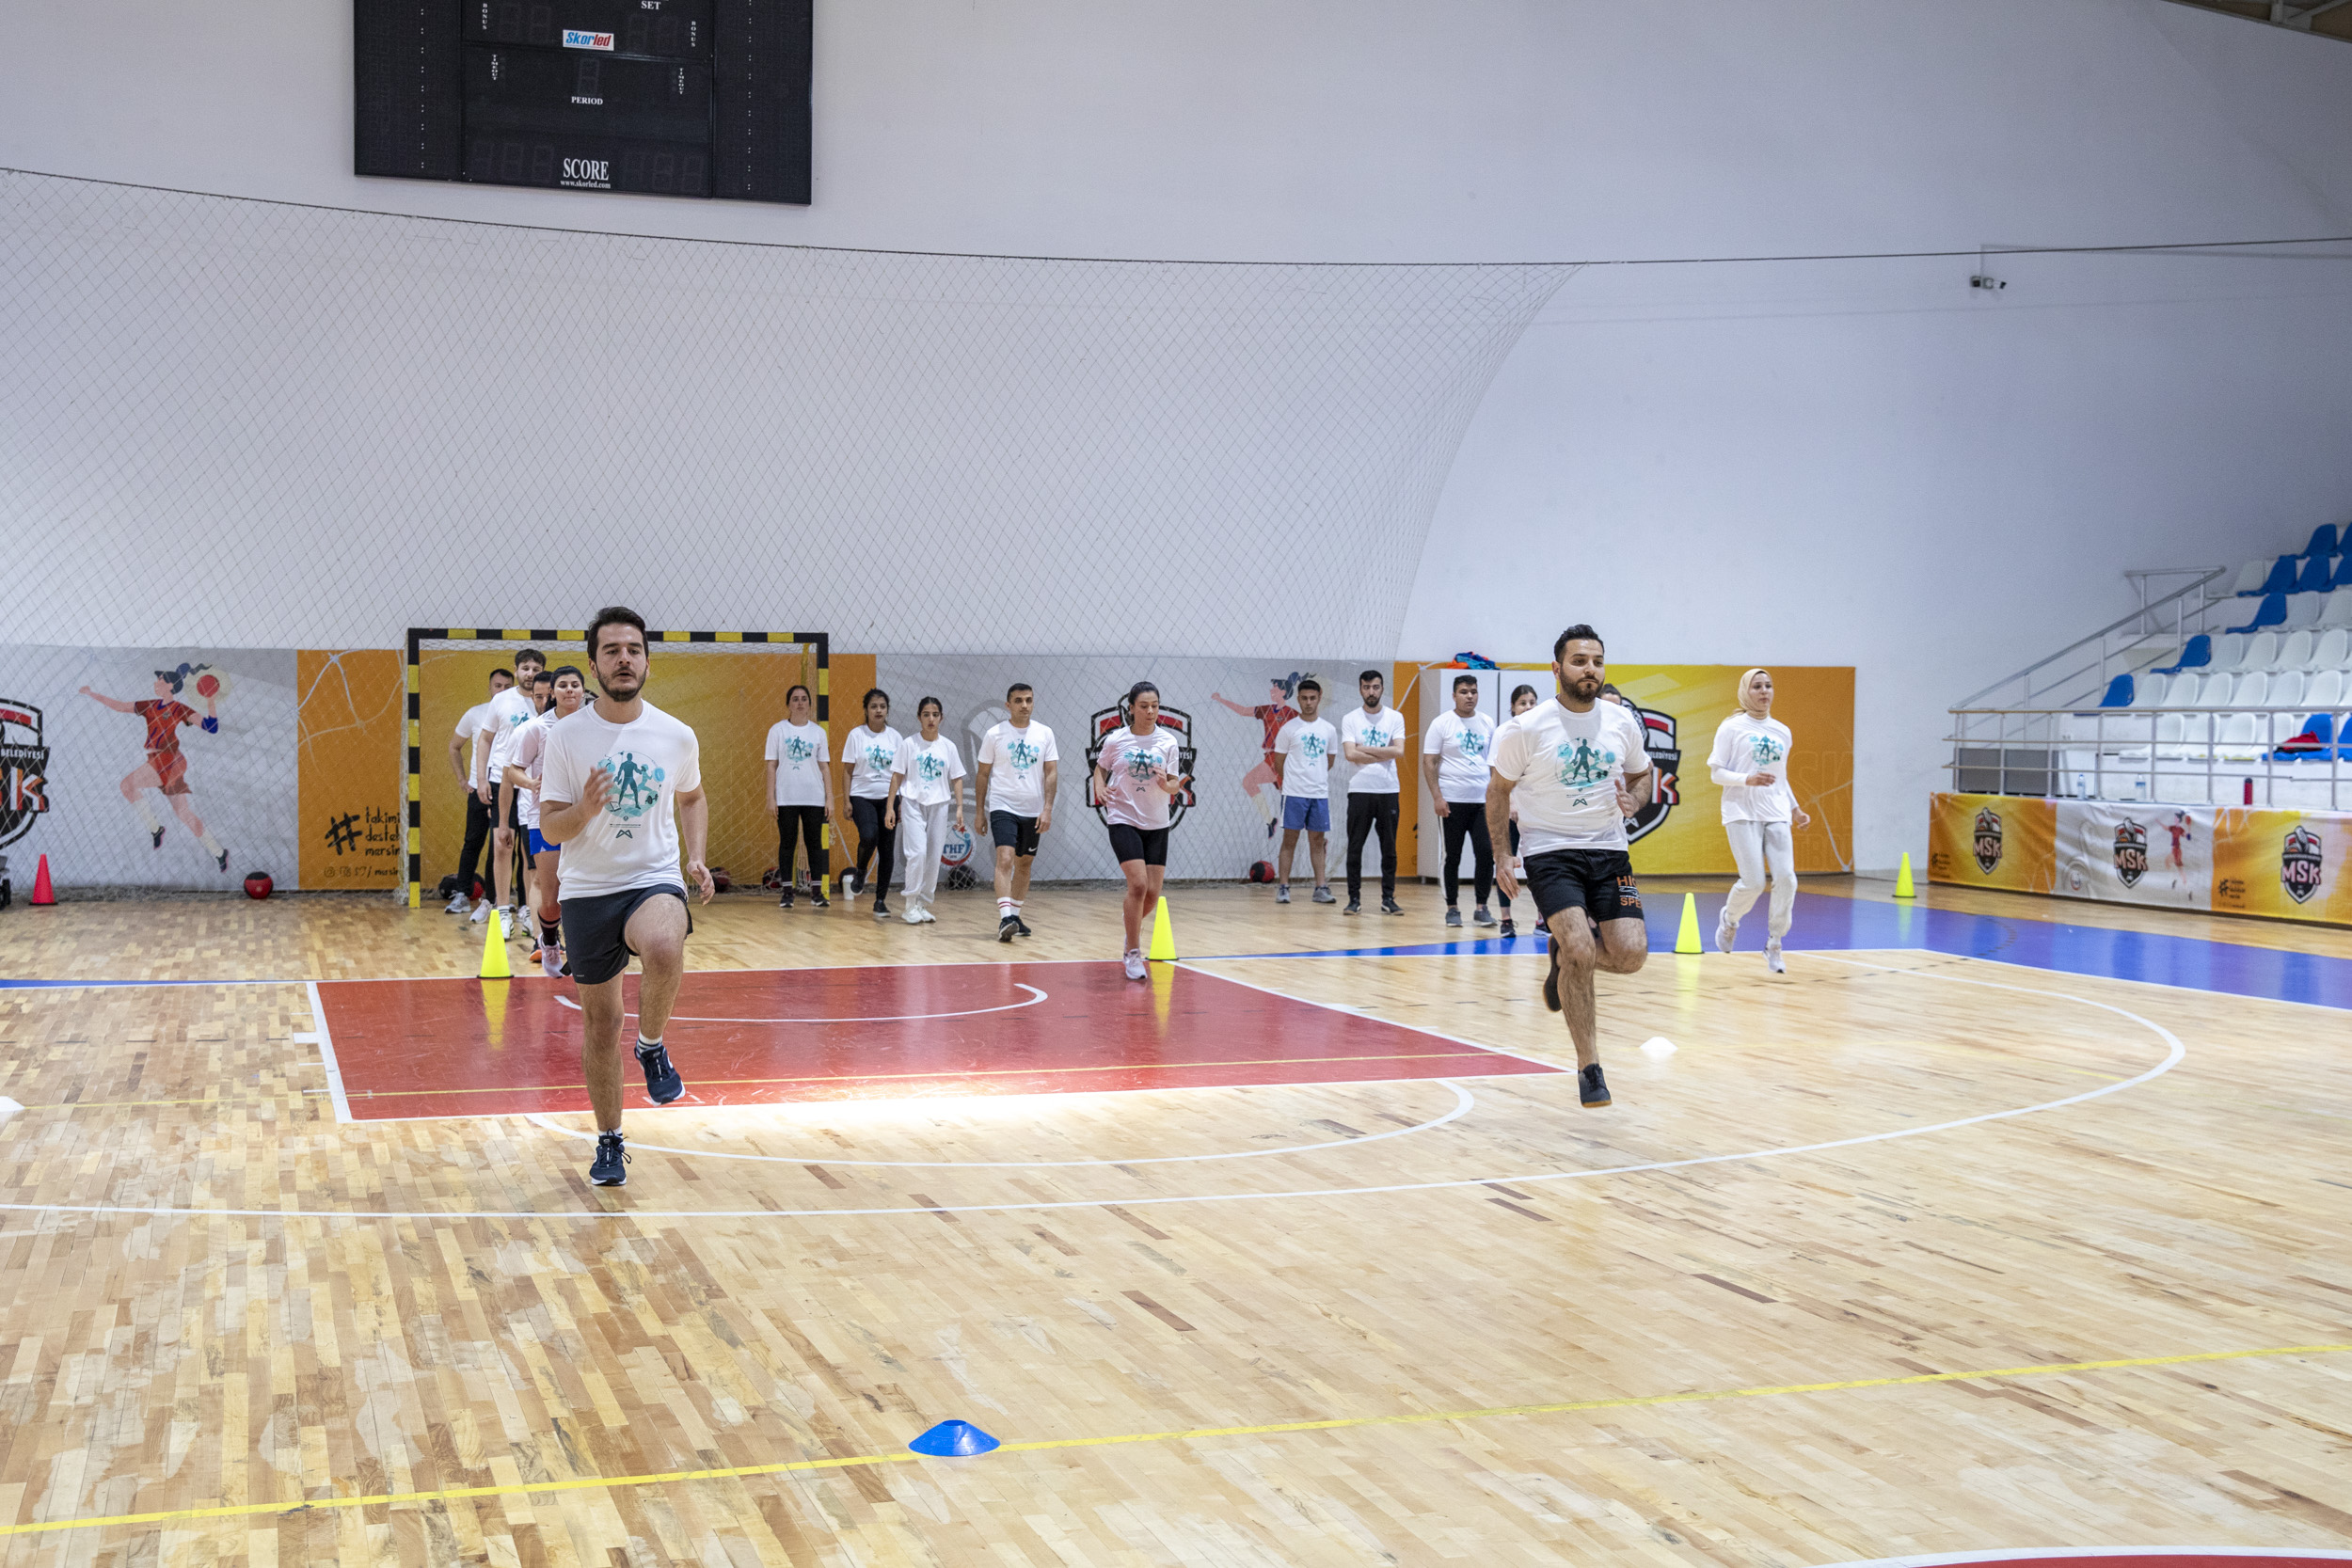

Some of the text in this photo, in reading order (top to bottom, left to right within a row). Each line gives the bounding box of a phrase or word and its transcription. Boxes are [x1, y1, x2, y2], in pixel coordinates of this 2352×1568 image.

[641, 1, 661, 10] SET
[565, 31, 612, 47] Skorled
[571, 96, 604, 105] PERIOD
[563, 158, 610, 181] SCORE
[560, 180, 612, 189] www.skorled.com
[1973, 836, 2002, 859] MSK
[2114, 848, 2148, 871] MSK
[2281, 860, 2321, 885] MSK
